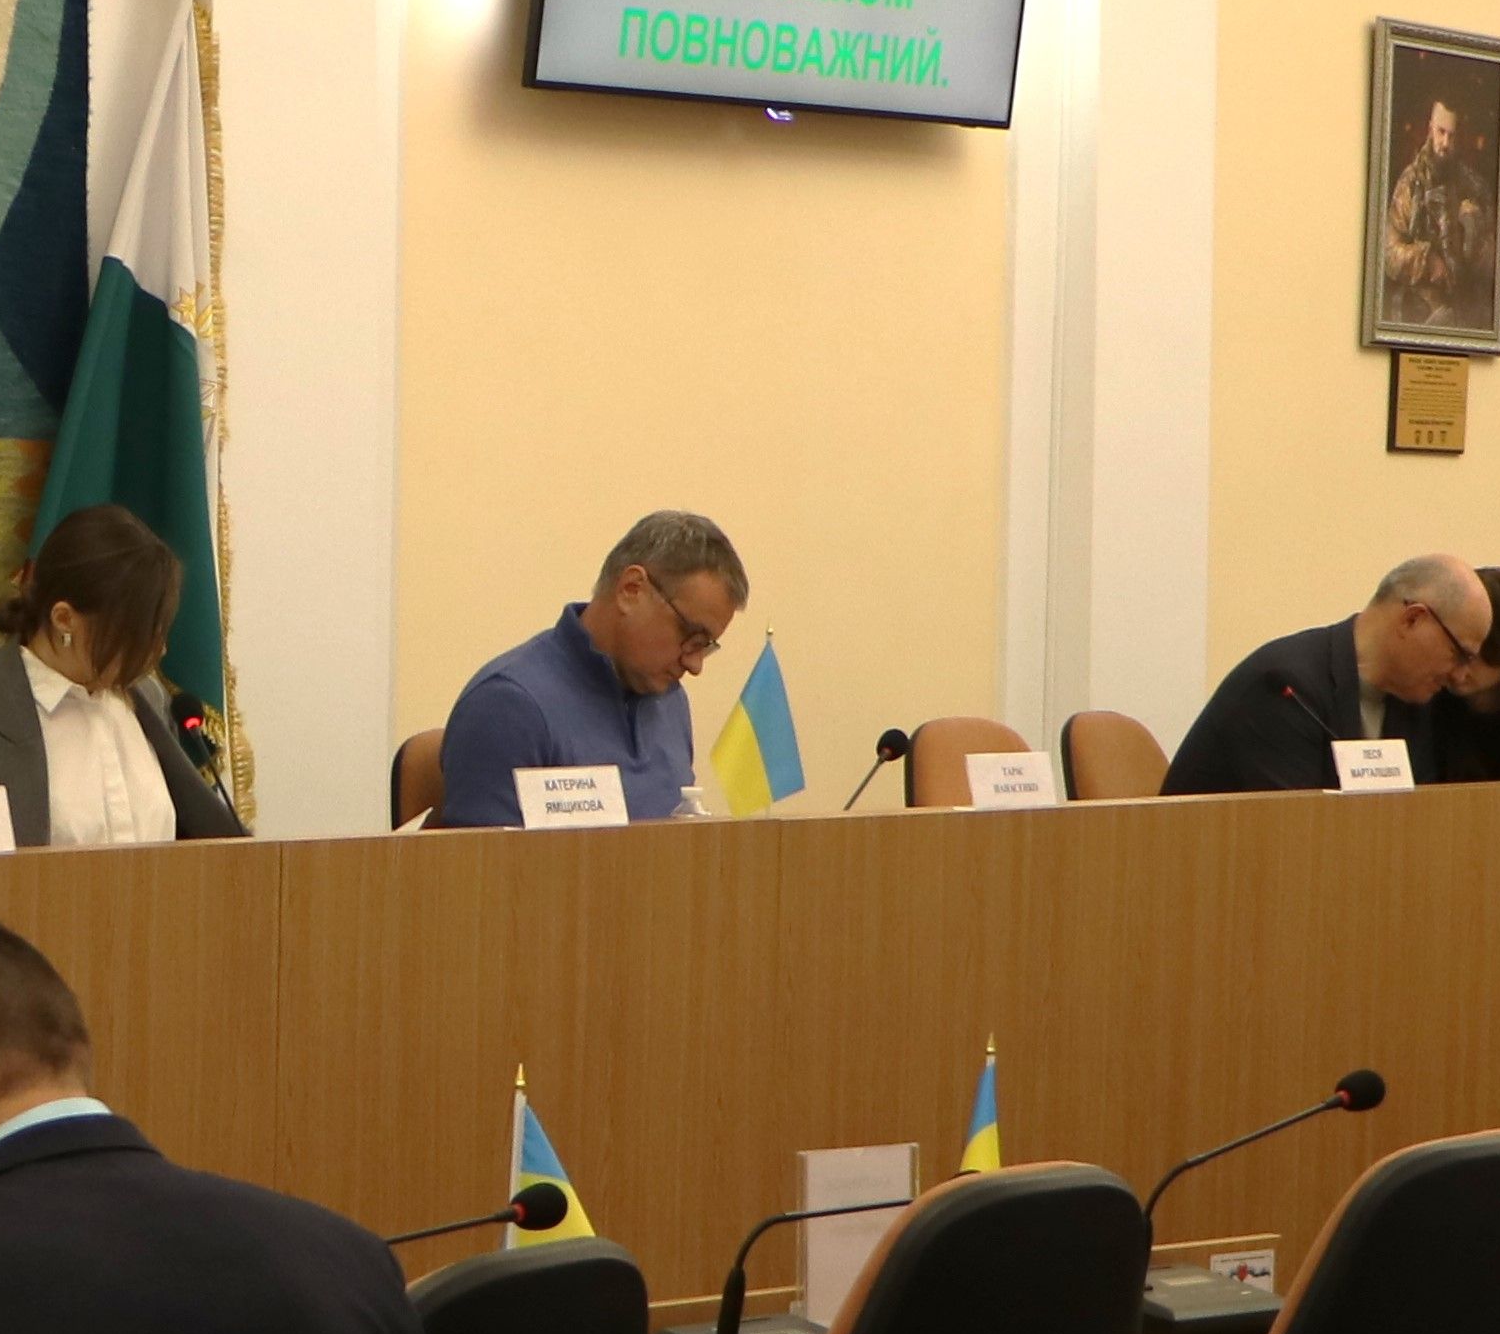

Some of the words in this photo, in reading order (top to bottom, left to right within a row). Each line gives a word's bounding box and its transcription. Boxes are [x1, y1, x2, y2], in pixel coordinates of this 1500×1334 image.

[618, 6, 949, 87] ПОВНОВАЖНИЙ.
[544, 777, 597, 792] КАТЕРИНА
[545, 798, 605, 816] ЯМЩИКОВА
